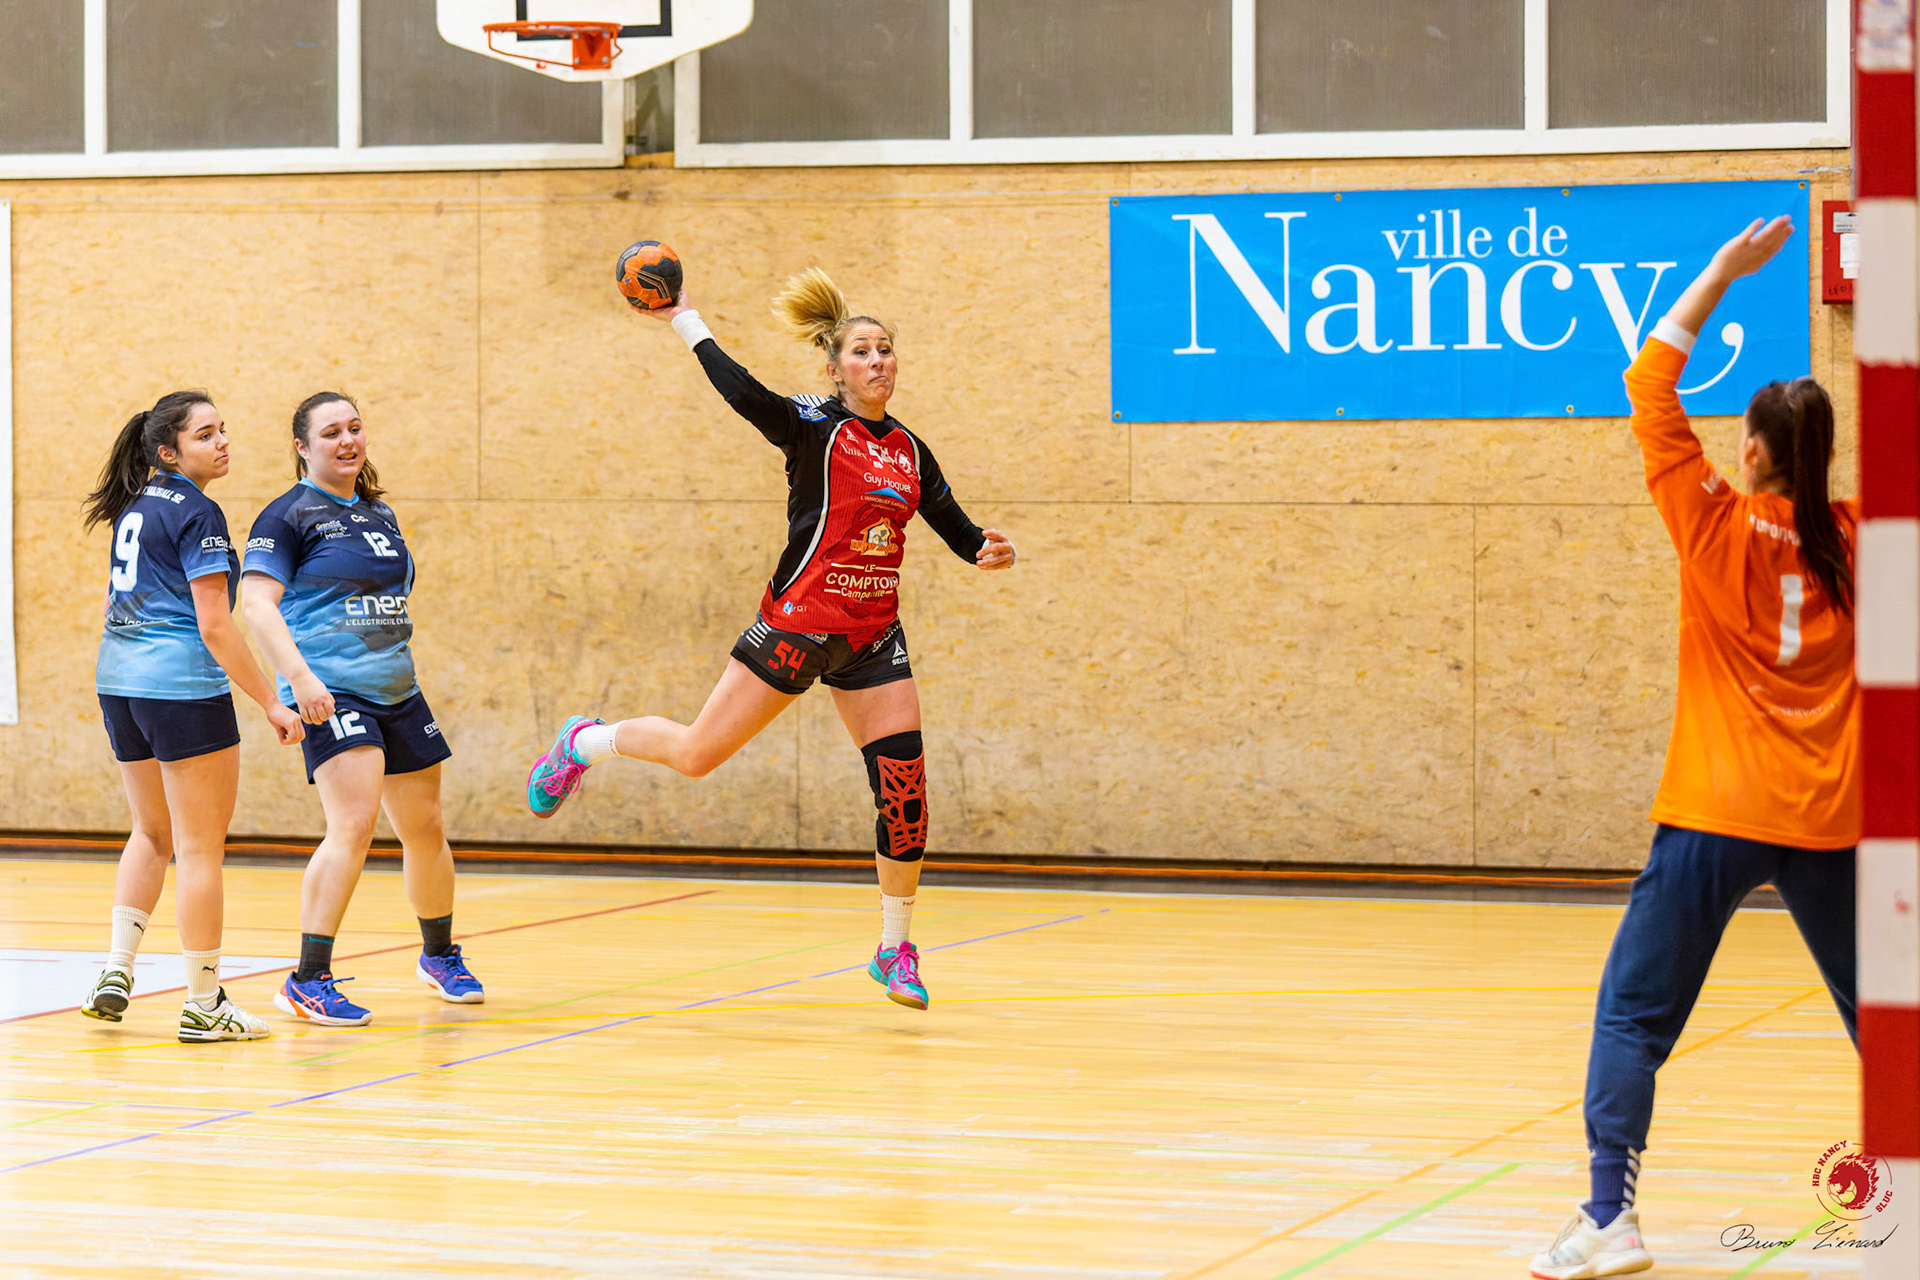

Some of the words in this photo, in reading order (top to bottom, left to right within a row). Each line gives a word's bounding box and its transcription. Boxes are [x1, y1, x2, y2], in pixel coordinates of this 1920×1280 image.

[1382, 208, 1493, 260] ville
[1508, 206, 1569, 258] de
[1171, 211, 1745, 395] Nancy
[863, 471, 882, 487] Guy
[883, 476, 913, 494] Hoquet
[112, 511, 144, 592] 9
[361, 531, 399, 557] 12
[864, 564, 877, 573] LE
[1775, 573, 1804, 666] 1
[767, 640, 807, 681] 54
[328, 708, 367, 741] 12
